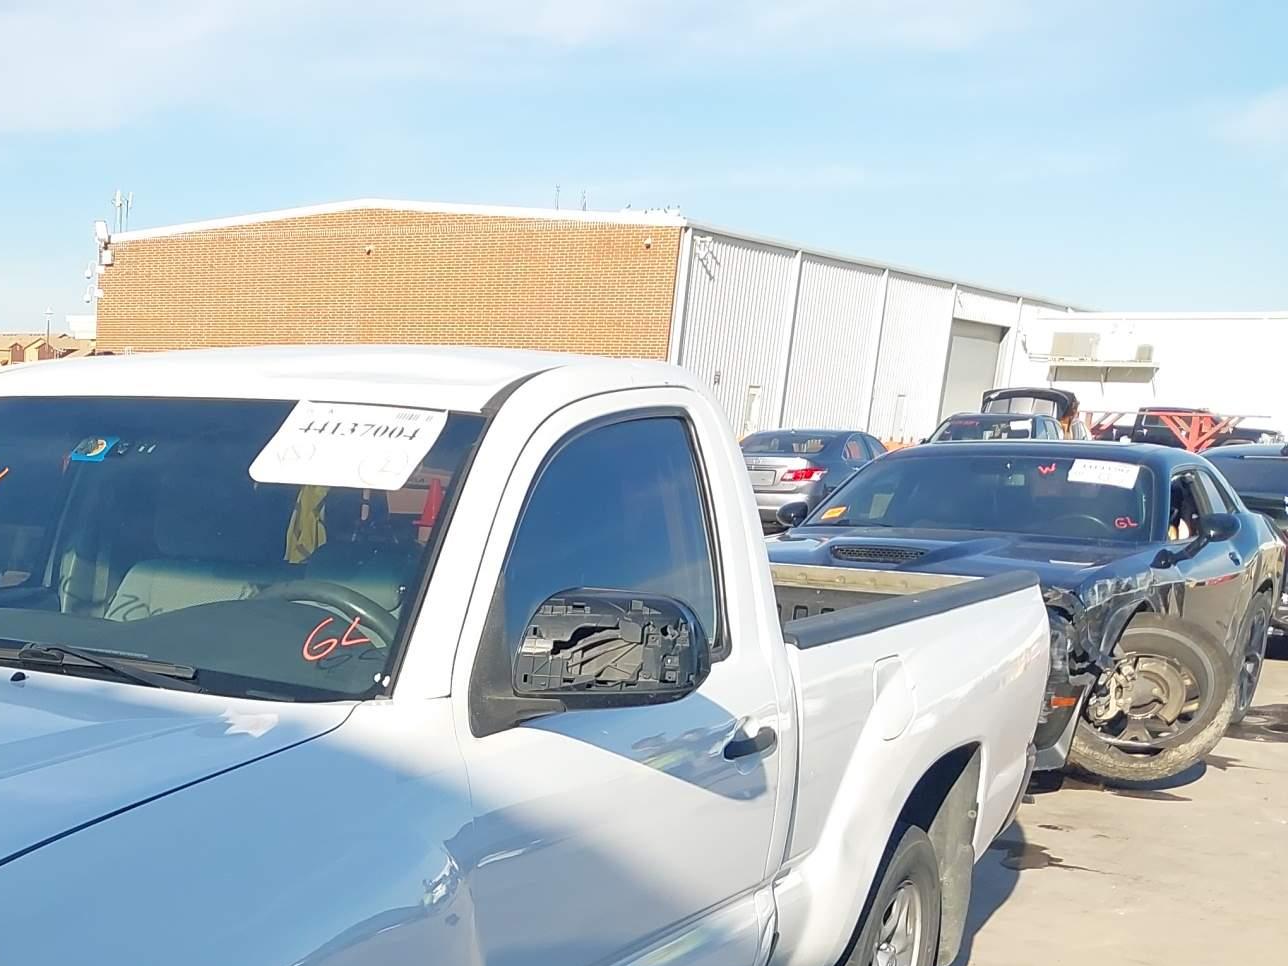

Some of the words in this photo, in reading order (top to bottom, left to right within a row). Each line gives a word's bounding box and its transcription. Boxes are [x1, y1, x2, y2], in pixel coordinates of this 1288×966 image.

[298, 420, 421, 441] 44137004
[1037, 463, 1057, 475] W
[1114, 516, 1139, 529] GL
